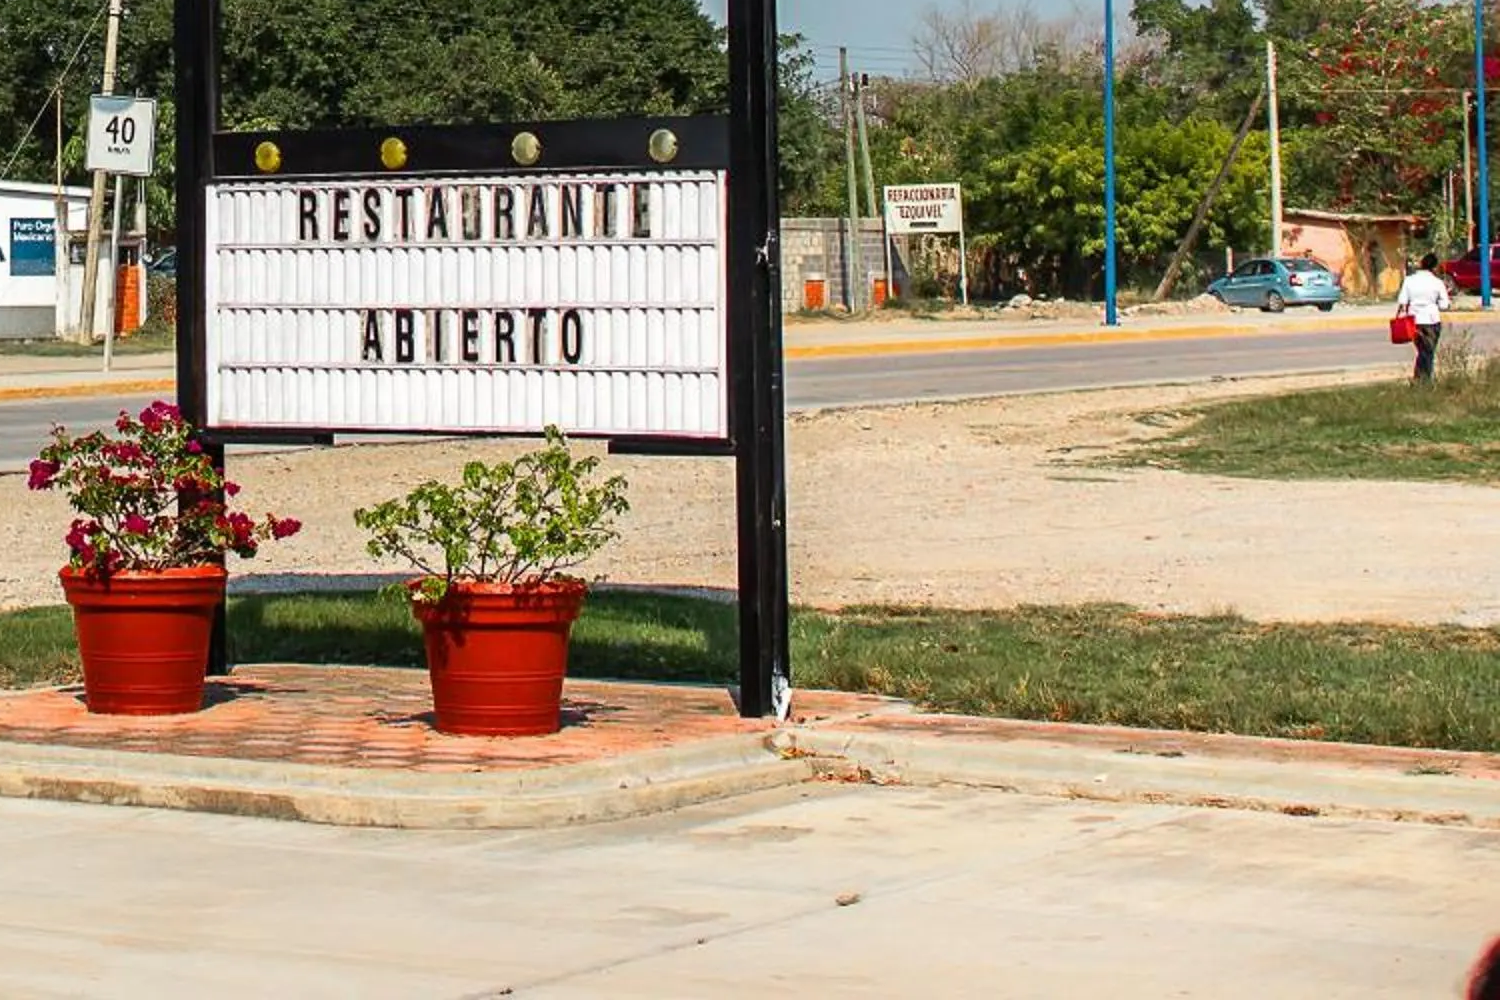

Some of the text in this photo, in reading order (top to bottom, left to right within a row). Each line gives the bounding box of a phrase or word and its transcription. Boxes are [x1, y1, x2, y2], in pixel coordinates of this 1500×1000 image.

[105, 115, 135, 145] 40
[299, 183, 651, 242] RESTAURANTE
[362, 308, 583, 364] ABIERTO
